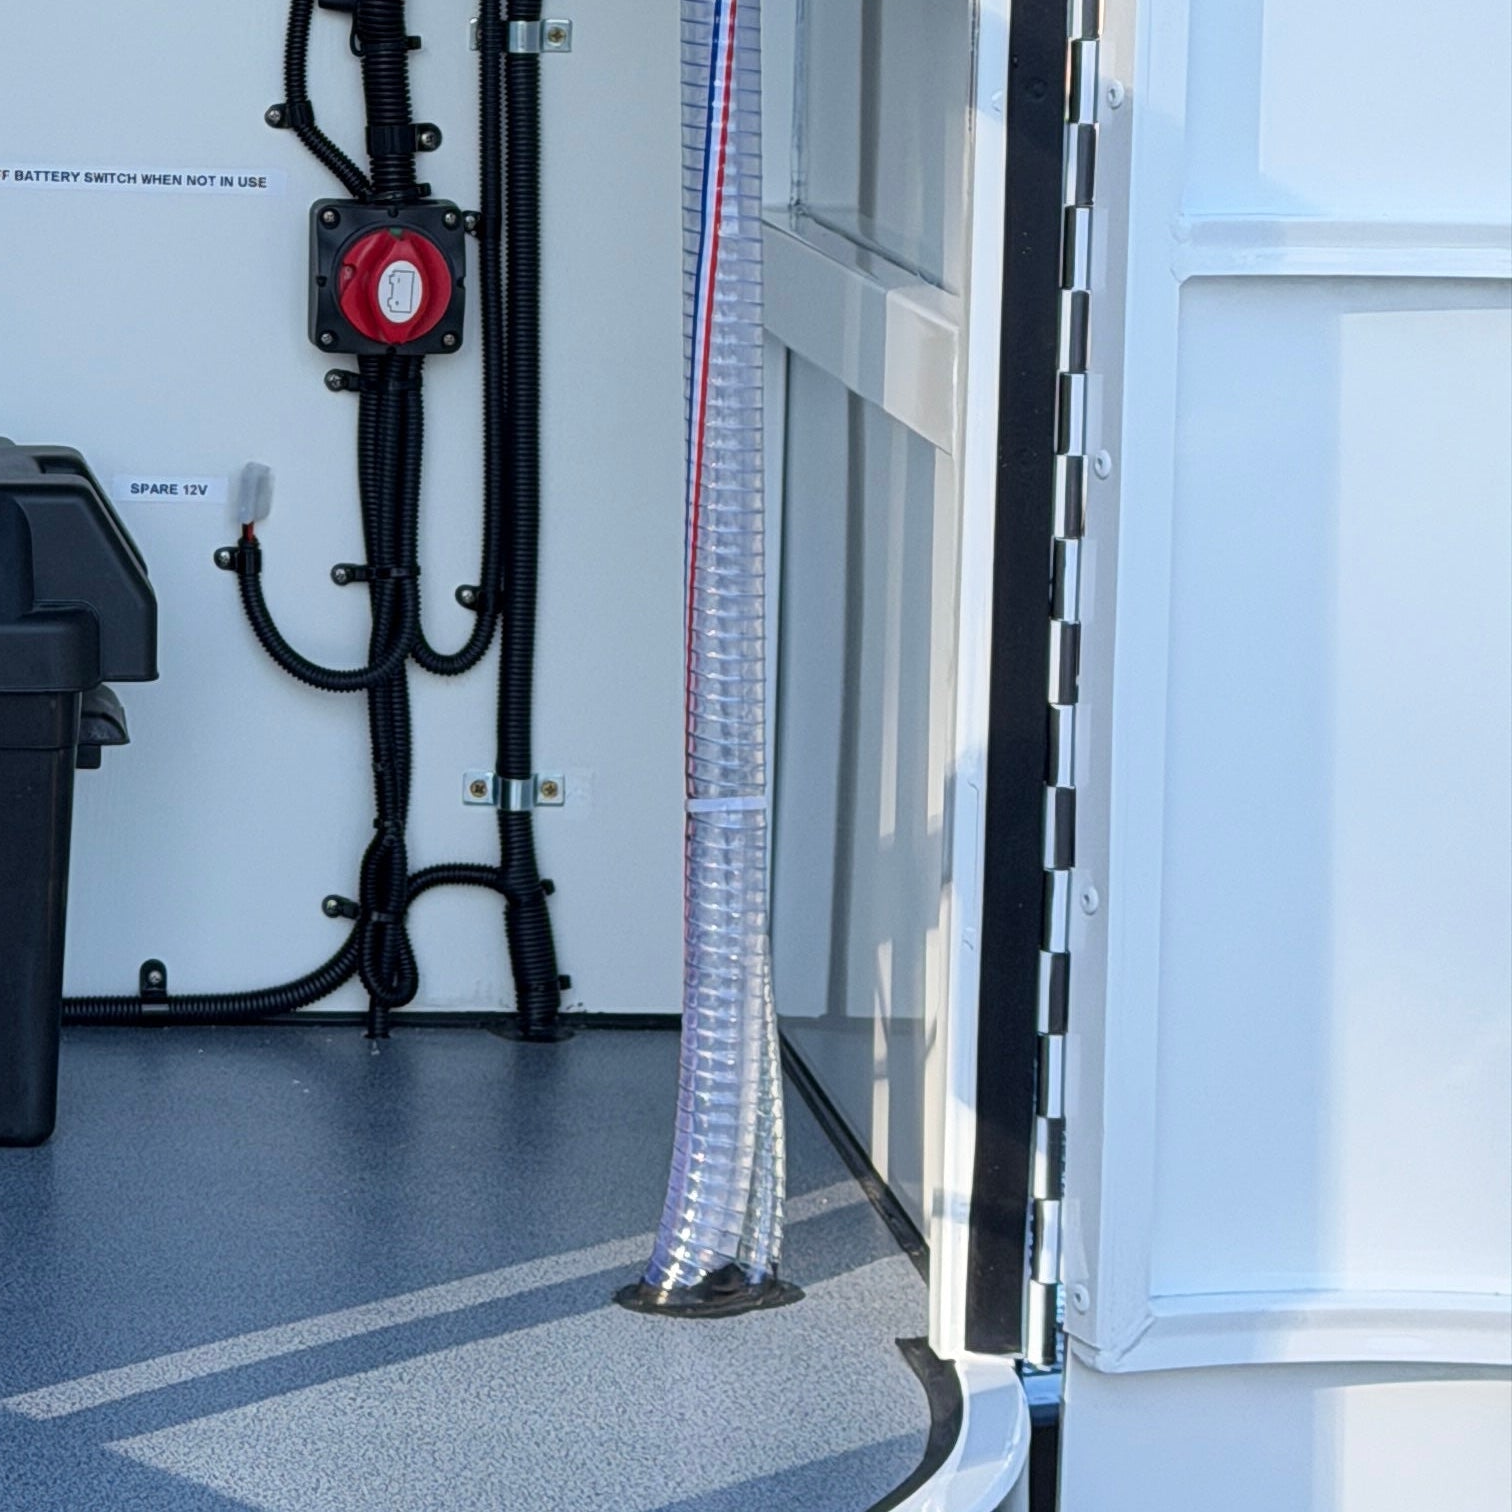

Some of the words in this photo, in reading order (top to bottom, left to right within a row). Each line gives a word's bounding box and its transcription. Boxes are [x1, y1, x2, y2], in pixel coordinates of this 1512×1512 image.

[13, 169, 81, 183] BATTERY
[84, 171, 137, 185] SWITCH
[141, 173, 182, 186] WHEN
[186, 174, 216, 187] NOT
[219, 175, 234, 187] IN
[237, 175, 267, 189] USE
[130, 482, 179, 495] SPARE
[182, 483, 208, 496] 12V
